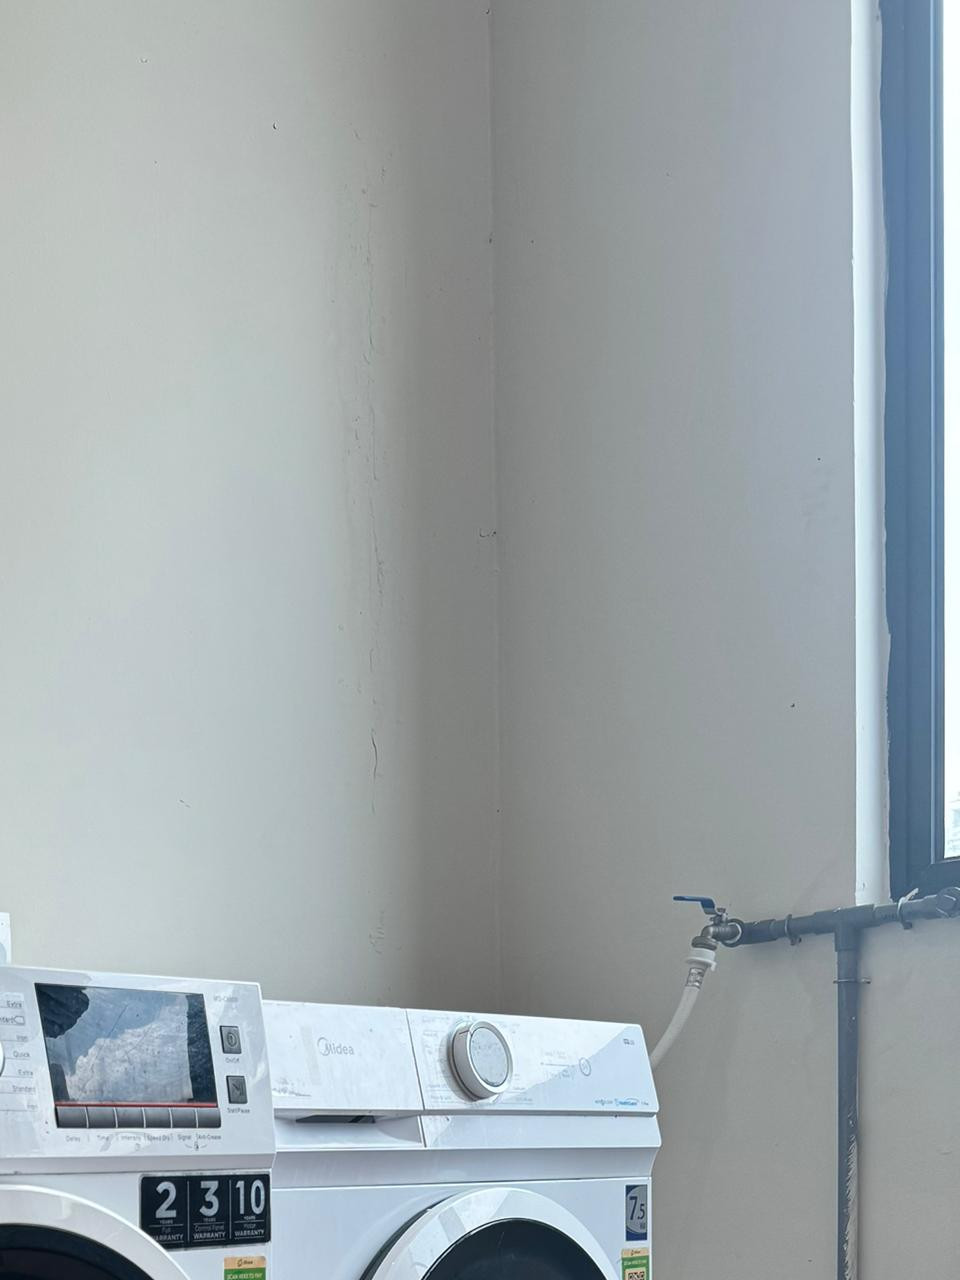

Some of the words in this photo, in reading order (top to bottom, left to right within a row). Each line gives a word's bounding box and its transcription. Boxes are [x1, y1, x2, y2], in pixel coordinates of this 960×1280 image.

[317, 1036, 355, 1057] Midea
[155, 1181, 177, 1219] 2
[200, 1181, 219, 1217] 3
[235, 1179, 266, 1215] 10
[628, 1196, 646, 1221] 7.5
[193, 1231, 226, 1240] WARRANTY
[234, 1229, 265, 1237] WARRANTY
